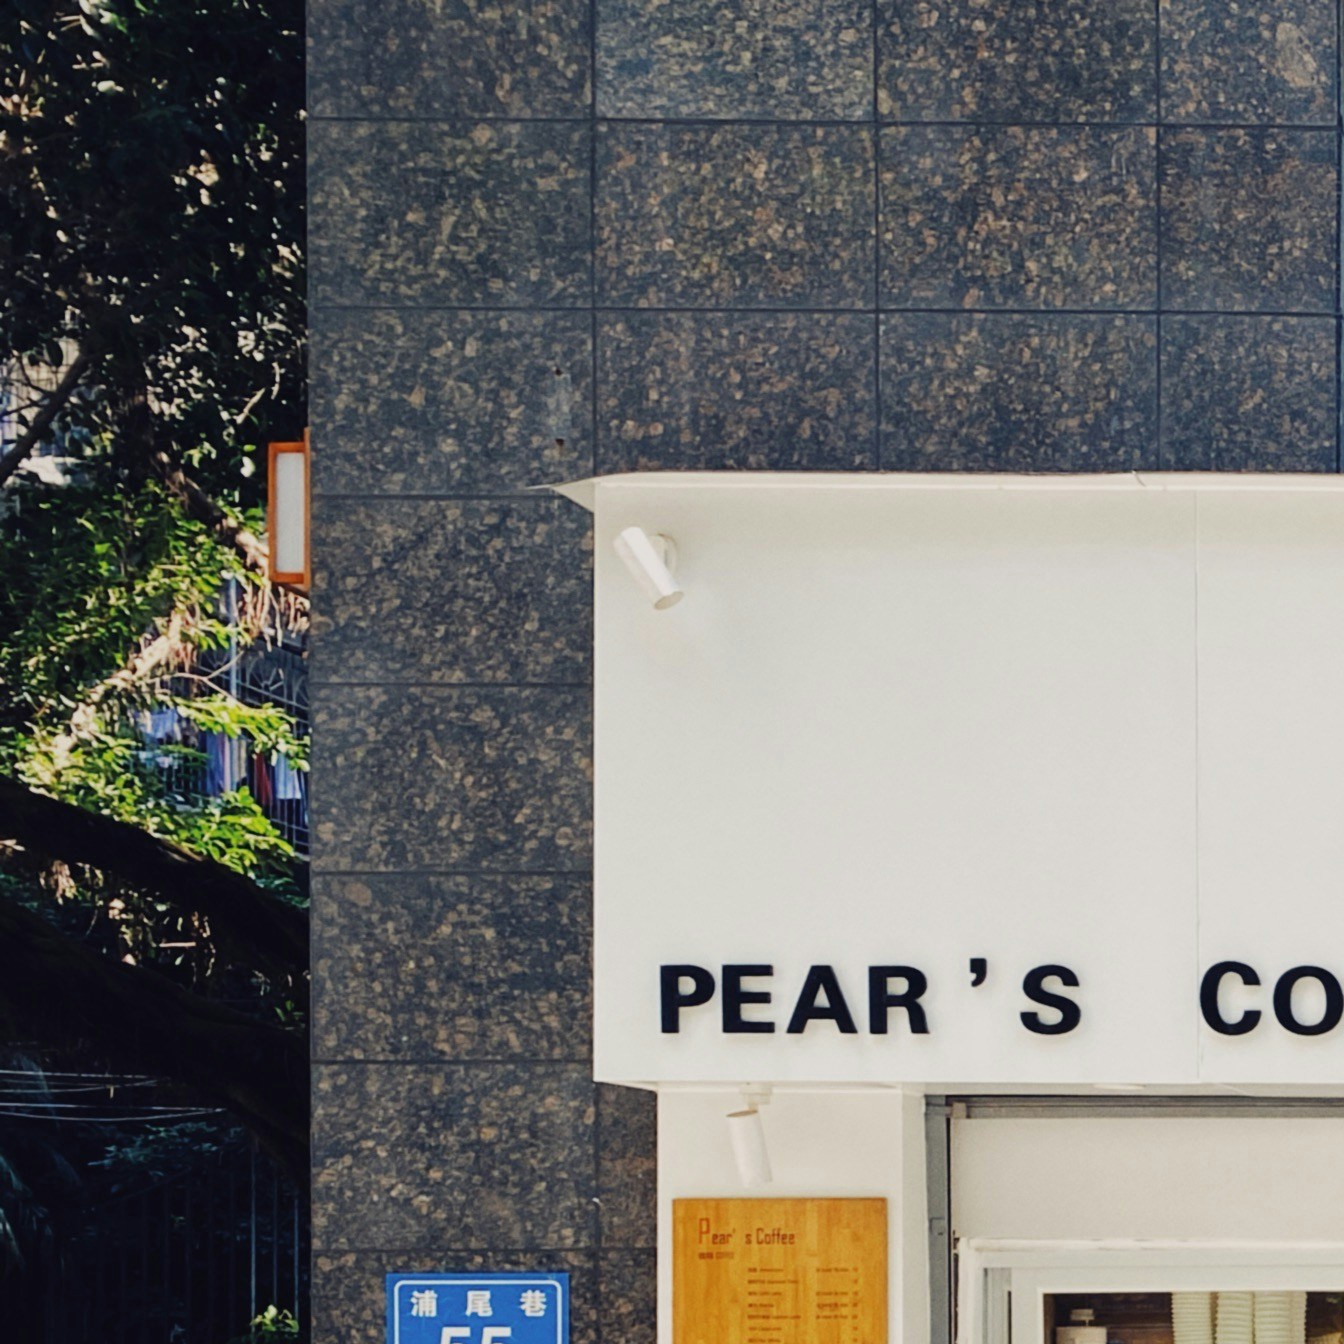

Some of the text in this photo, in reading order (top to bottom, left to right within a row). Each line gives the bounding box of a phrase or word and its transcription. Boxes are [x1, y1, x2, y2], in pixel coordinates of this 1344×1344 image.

[660, 957, 1082, 1036] PEAR'S
[756, 1227, 796, 1245] Coffee
[410, 1289, 547, 1318] 浦尾巷
